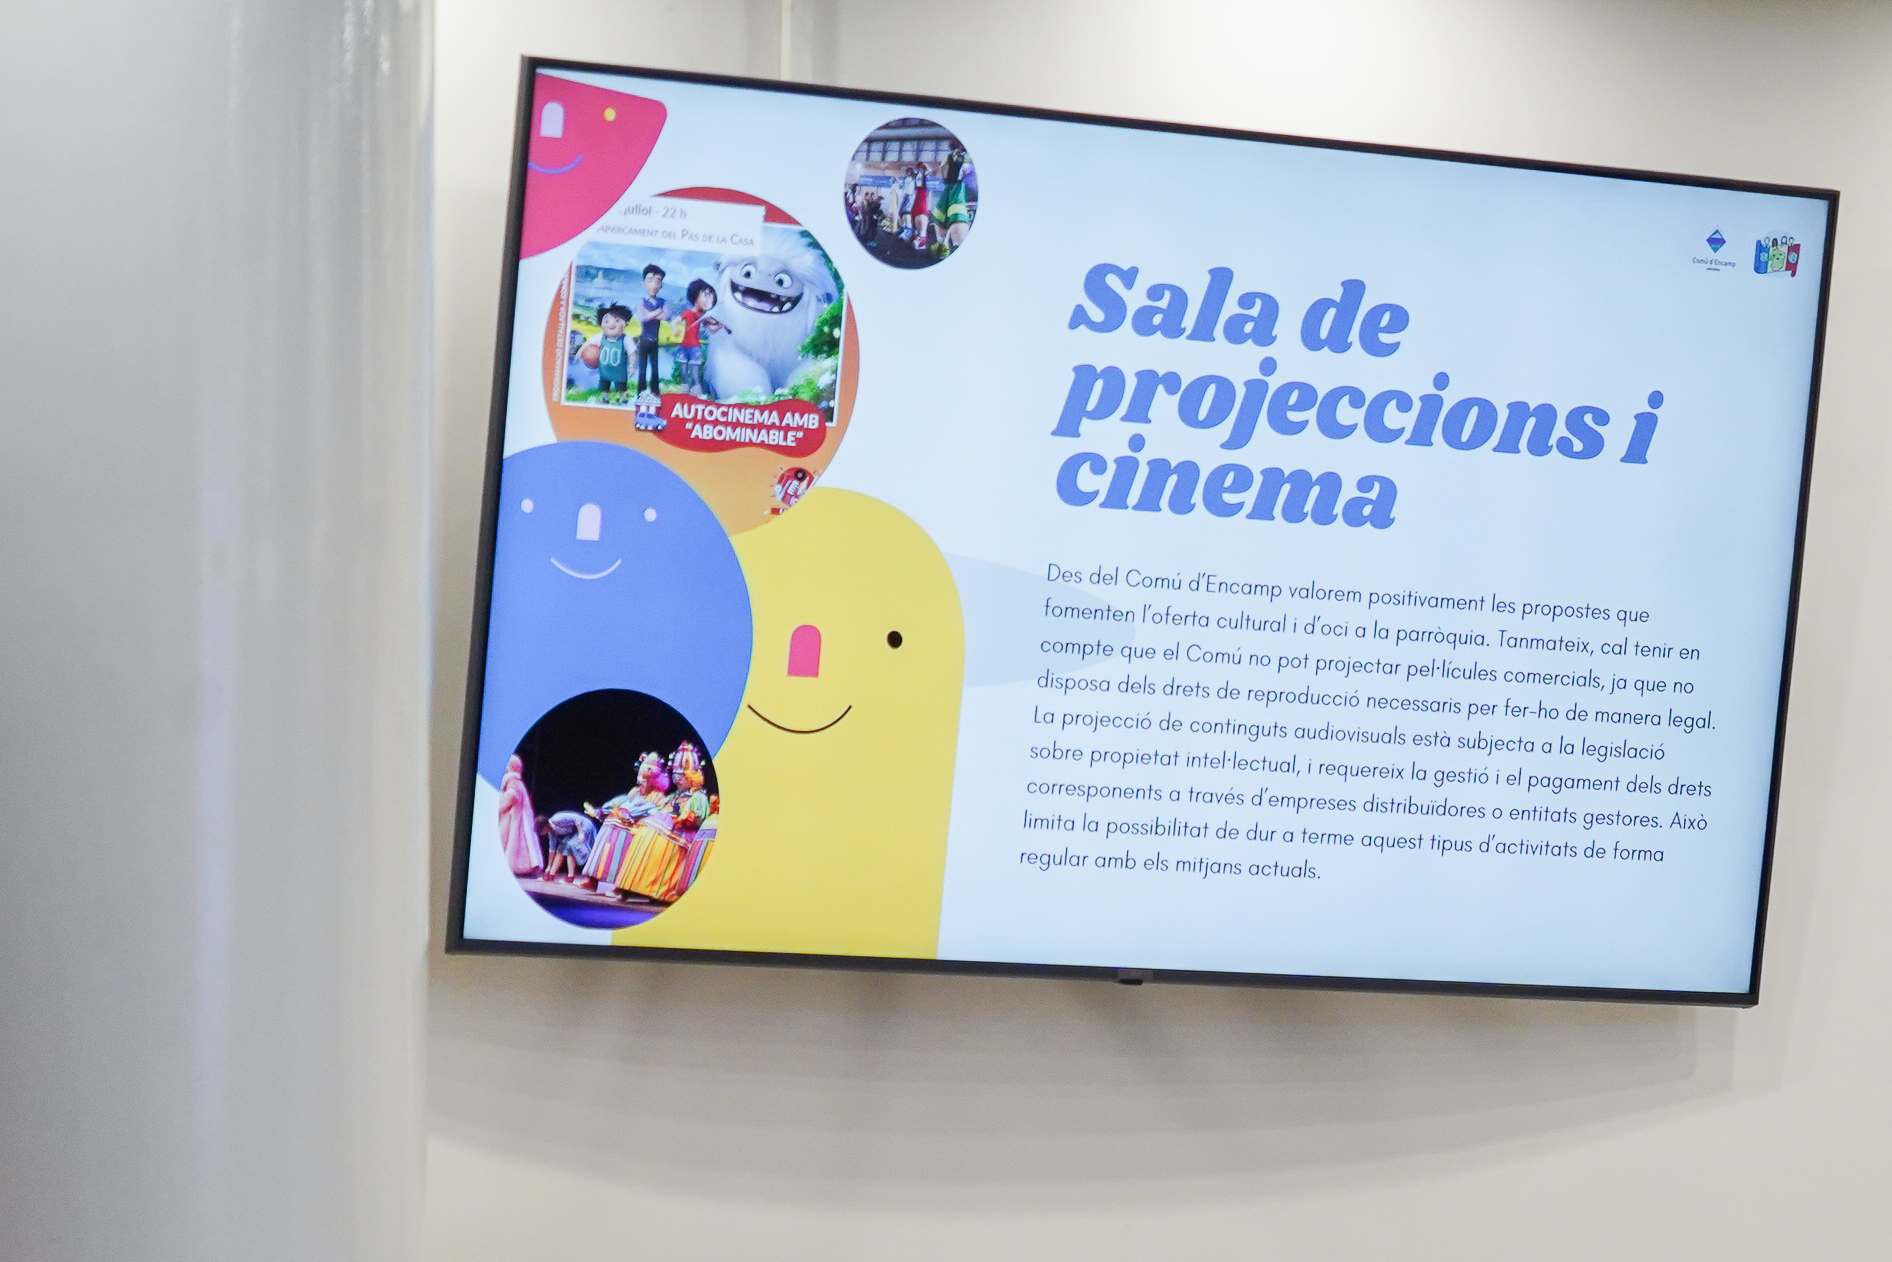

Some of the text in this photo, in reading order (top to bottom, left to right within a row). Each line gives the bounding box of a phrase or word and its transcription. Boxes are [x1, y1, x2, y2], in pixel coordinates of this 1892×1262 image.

[661, 230, 678, 240] DEL
[662, 205, 676, 219] 22
[680, 206, 688, 219] h
[1067, 262, 1411, 359] Sala de
[670, 402, 820, 430] AUTOCINEMA AMB
[1050, 356, 1666, 465] projeccions i
[1056, 433, 1398, 530] cinema
[1047, 563, 1650, 628] Des del Comú d'Encamp valorem positivament les propostes que
[1044, 596, 1700, 661] fomenten l'oferta cultural i d'oci a la parròquia. Tanmateix, cal tenir en
[1040, 639, 1695, 698] compte que el Comú no pot projectar pel·lícules comercials, ja que no
[1037, 668, 1716, 735] disposa dels drets de reproducció necessaris per fer-ho de manera legal.
[1033, 704, 1665, 763] La projecció de continguts audiovisuals està subjecta a la legislació
[1029, 740, 1712, 798] sobre propietat intel·lectual, i requereix la gestió i el pagament dels drets
[1026, 781, 1708, 831] corresponents a través d'empreses distribuïdores o entitats gestores. Això
[1019, 846, 1321, 880] regular amb els mitjans actuals.
[1023, 809, 1665, 863] limita la possibilitat de dur a terme aquest tipus d'activitats de forma
